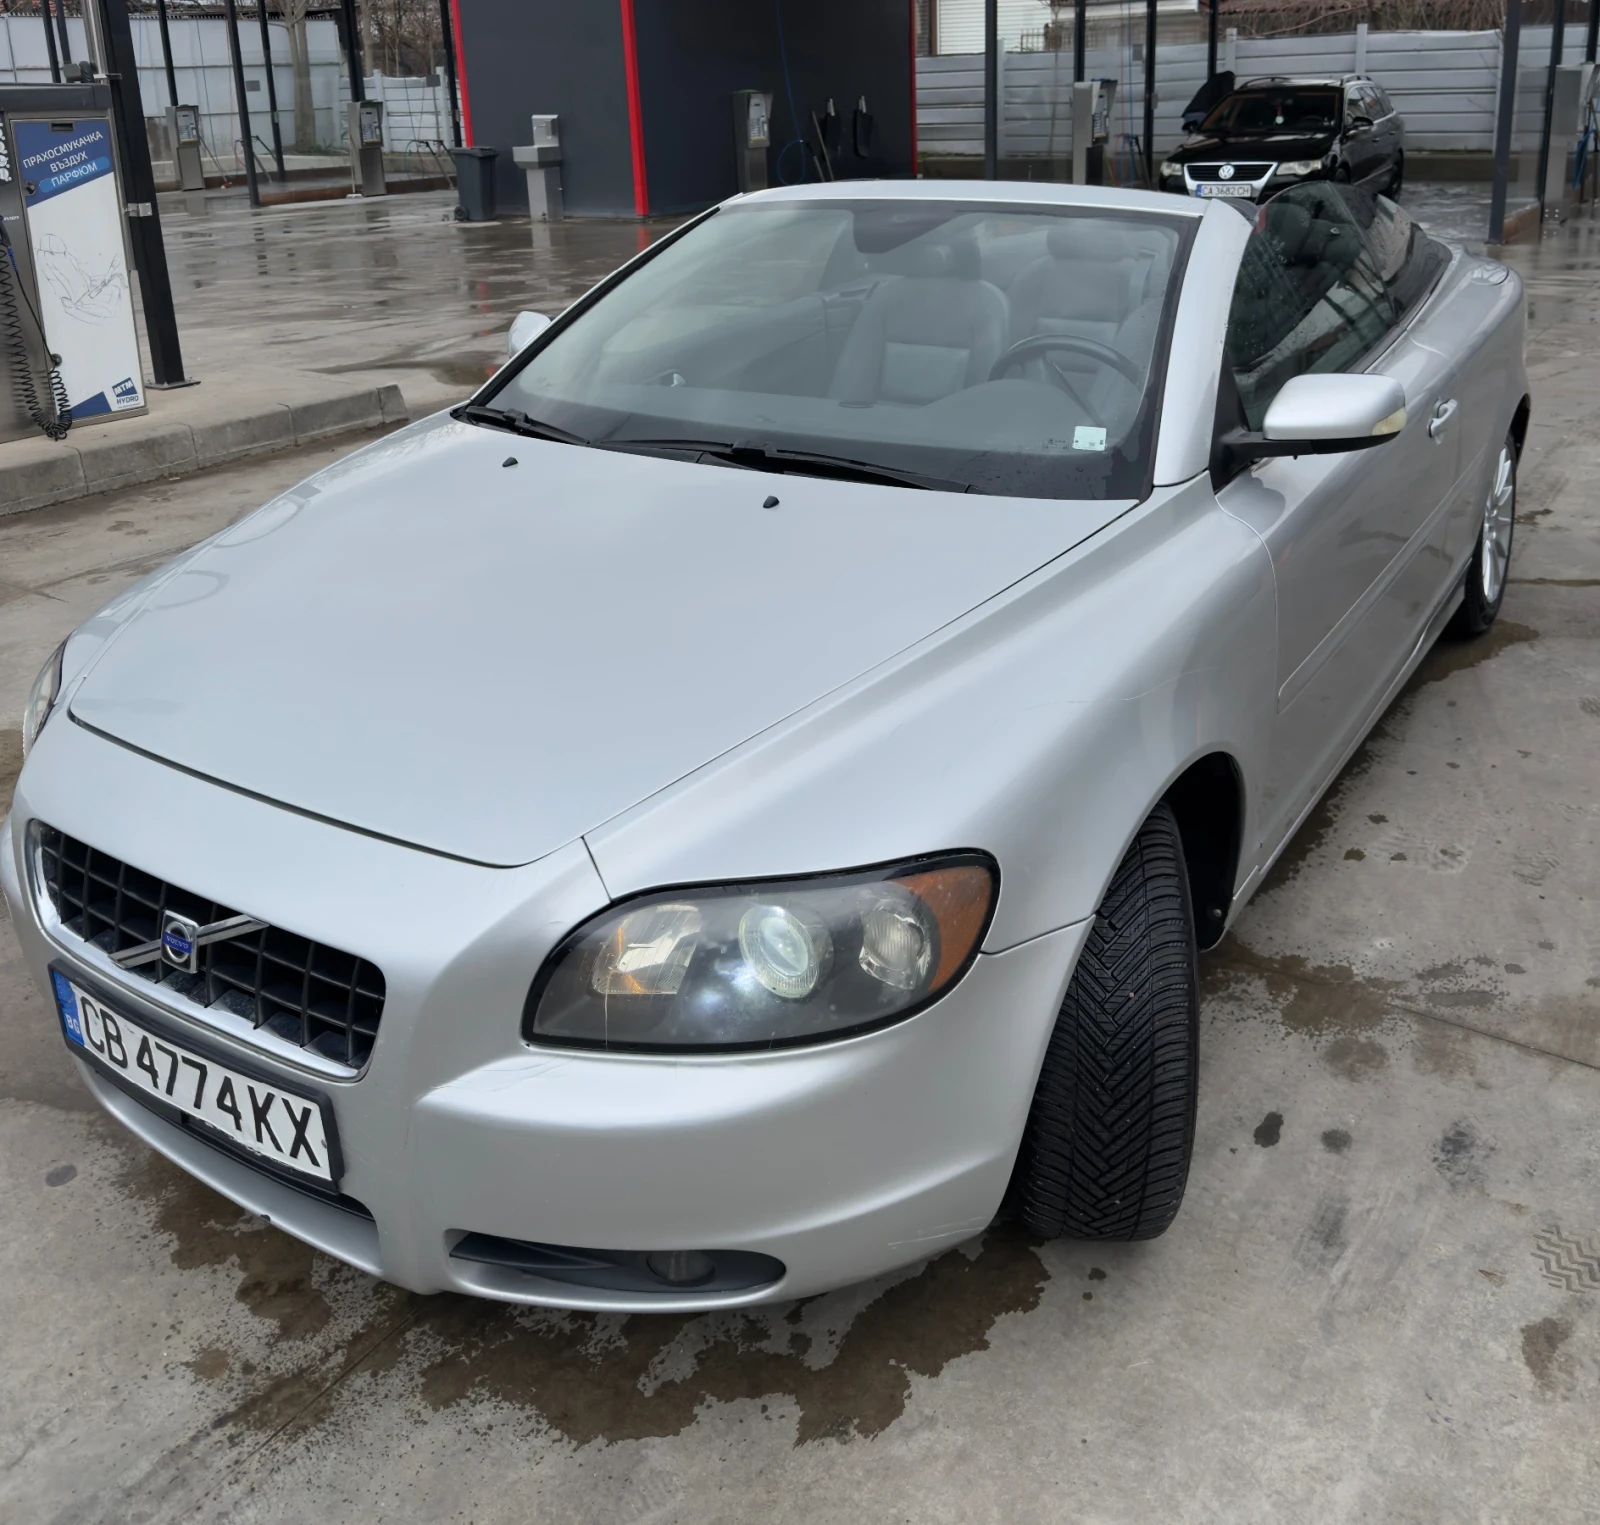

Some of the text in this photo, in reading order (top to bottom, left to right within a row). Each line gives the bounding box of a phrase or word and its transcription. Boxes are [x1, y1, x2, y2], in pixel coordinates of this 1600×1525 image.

[22, 130, 104, 169] ПРАХОСМУКАЧКА
[49, 150, 88, 173] ВЪЗДУХ
[51, 161, 98, 187] ПАРФЮМ
[113, 379, 134, 396] MTM
[116, 395, 139, 405] HYDRO
[65, 1012, 81, 1036] BG
